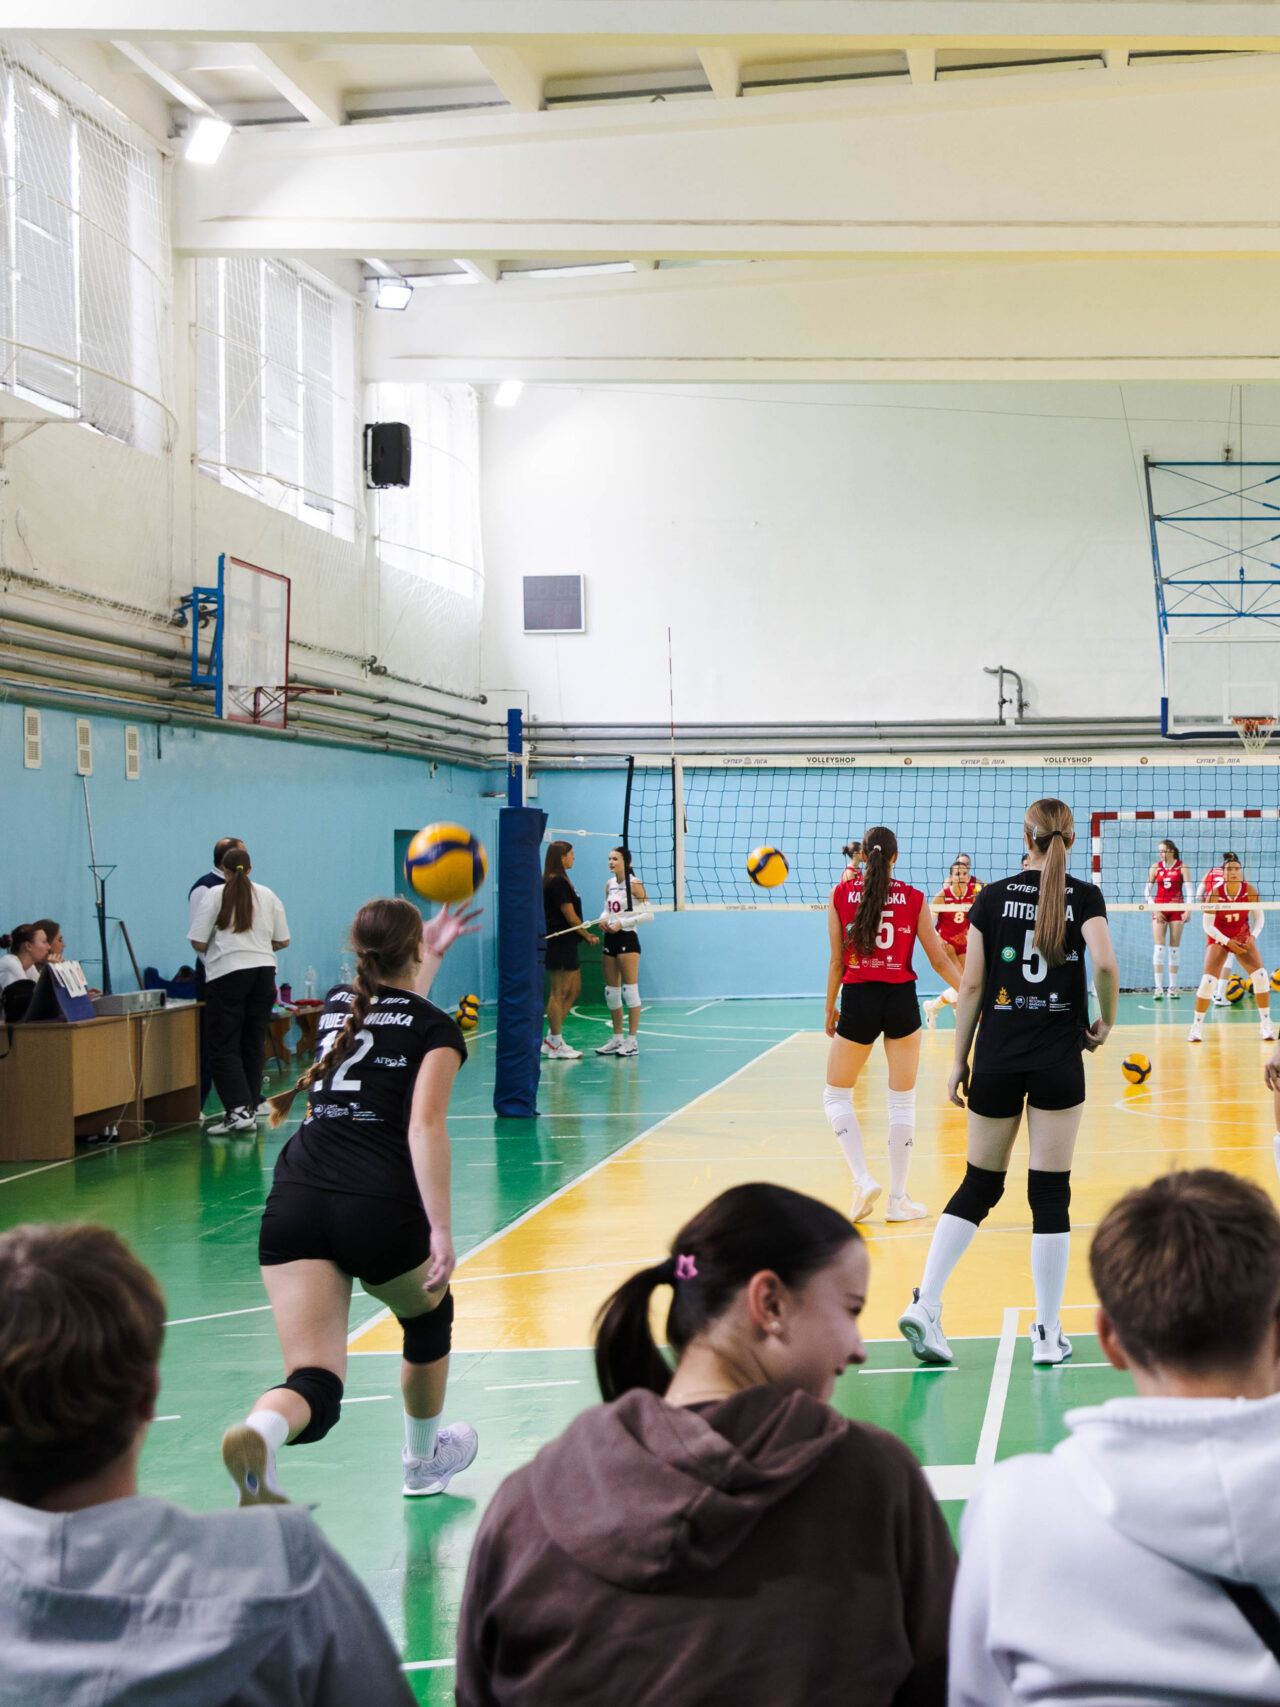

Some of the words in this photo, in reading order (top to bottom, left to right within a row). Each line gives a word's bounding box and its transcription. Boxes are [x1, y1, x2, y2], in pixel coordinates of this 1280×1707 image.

[806, 756, 856, 764] VOLLEYSHOP
[1043, 756, 1093, 764] VOLLEYSHOP
[1006, 883, 1038, 894] СУПЕР
[1163, 877, 1172, 889] 5
[607, 900, 621, 913] 10
[953, 911, 965, 924] 8
[1022, 929, 1048, 984] 5
[313, 1029, 375, 1093] 12
